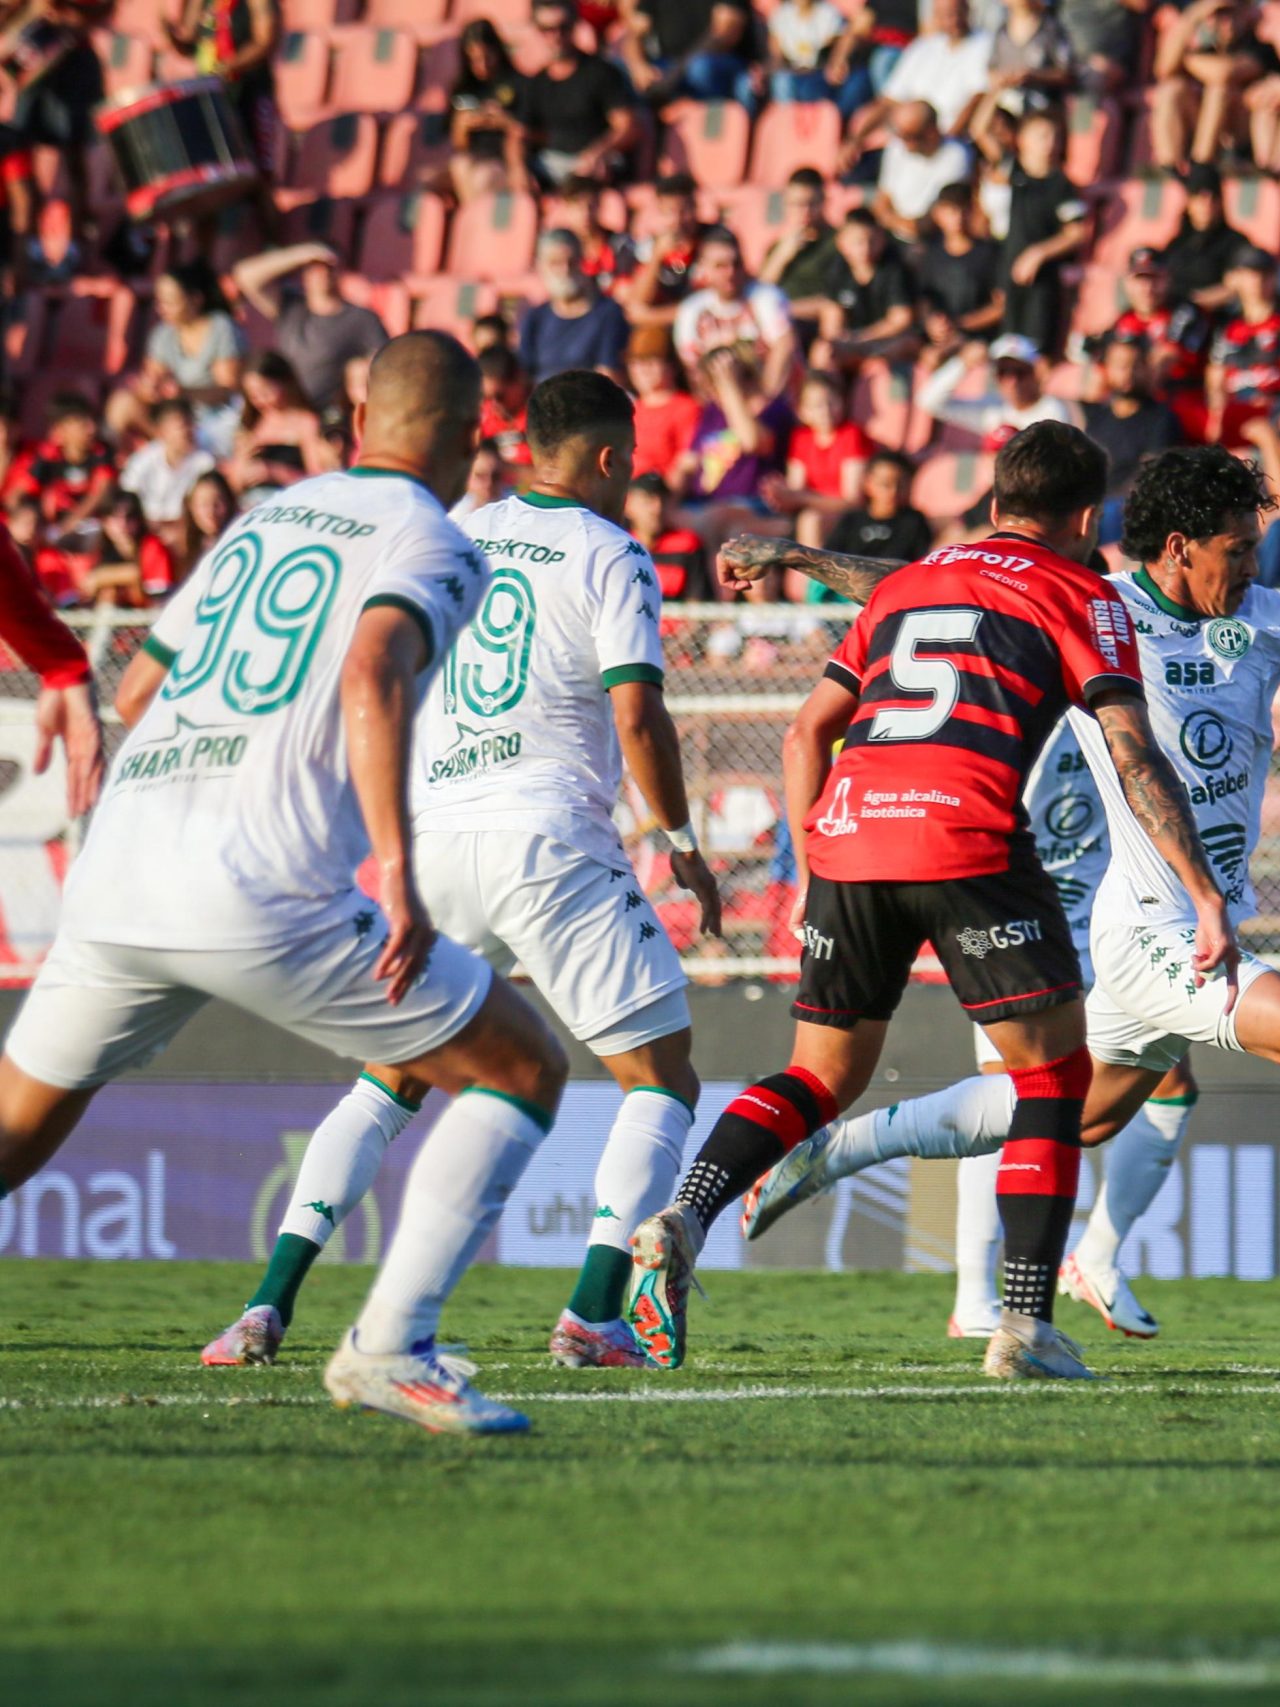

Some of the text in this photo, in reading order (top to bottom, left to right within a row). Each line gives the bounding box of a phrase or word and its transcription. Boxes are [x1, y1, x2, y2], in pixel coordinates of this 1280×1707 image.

[259, 505, 377, 539] DESKTOP
[940, 548, 1035, 573] Euro17
[979, 569, 1029, 592] CRÉDITO
[161, 530, 343, 715] 99
[1108, 600, 1131, 646] BODY
[867, 608, 984, 742] 5
[1165, 661, 1215, 686] asa
[189, 733, 249, 769] PRO
[480, 731, 522, 767] PRO
[860, 805, 926, 819] isotônica
[863, 787, 960, 808] água alcalina
[528, 1192, 593, 1236] uhl
